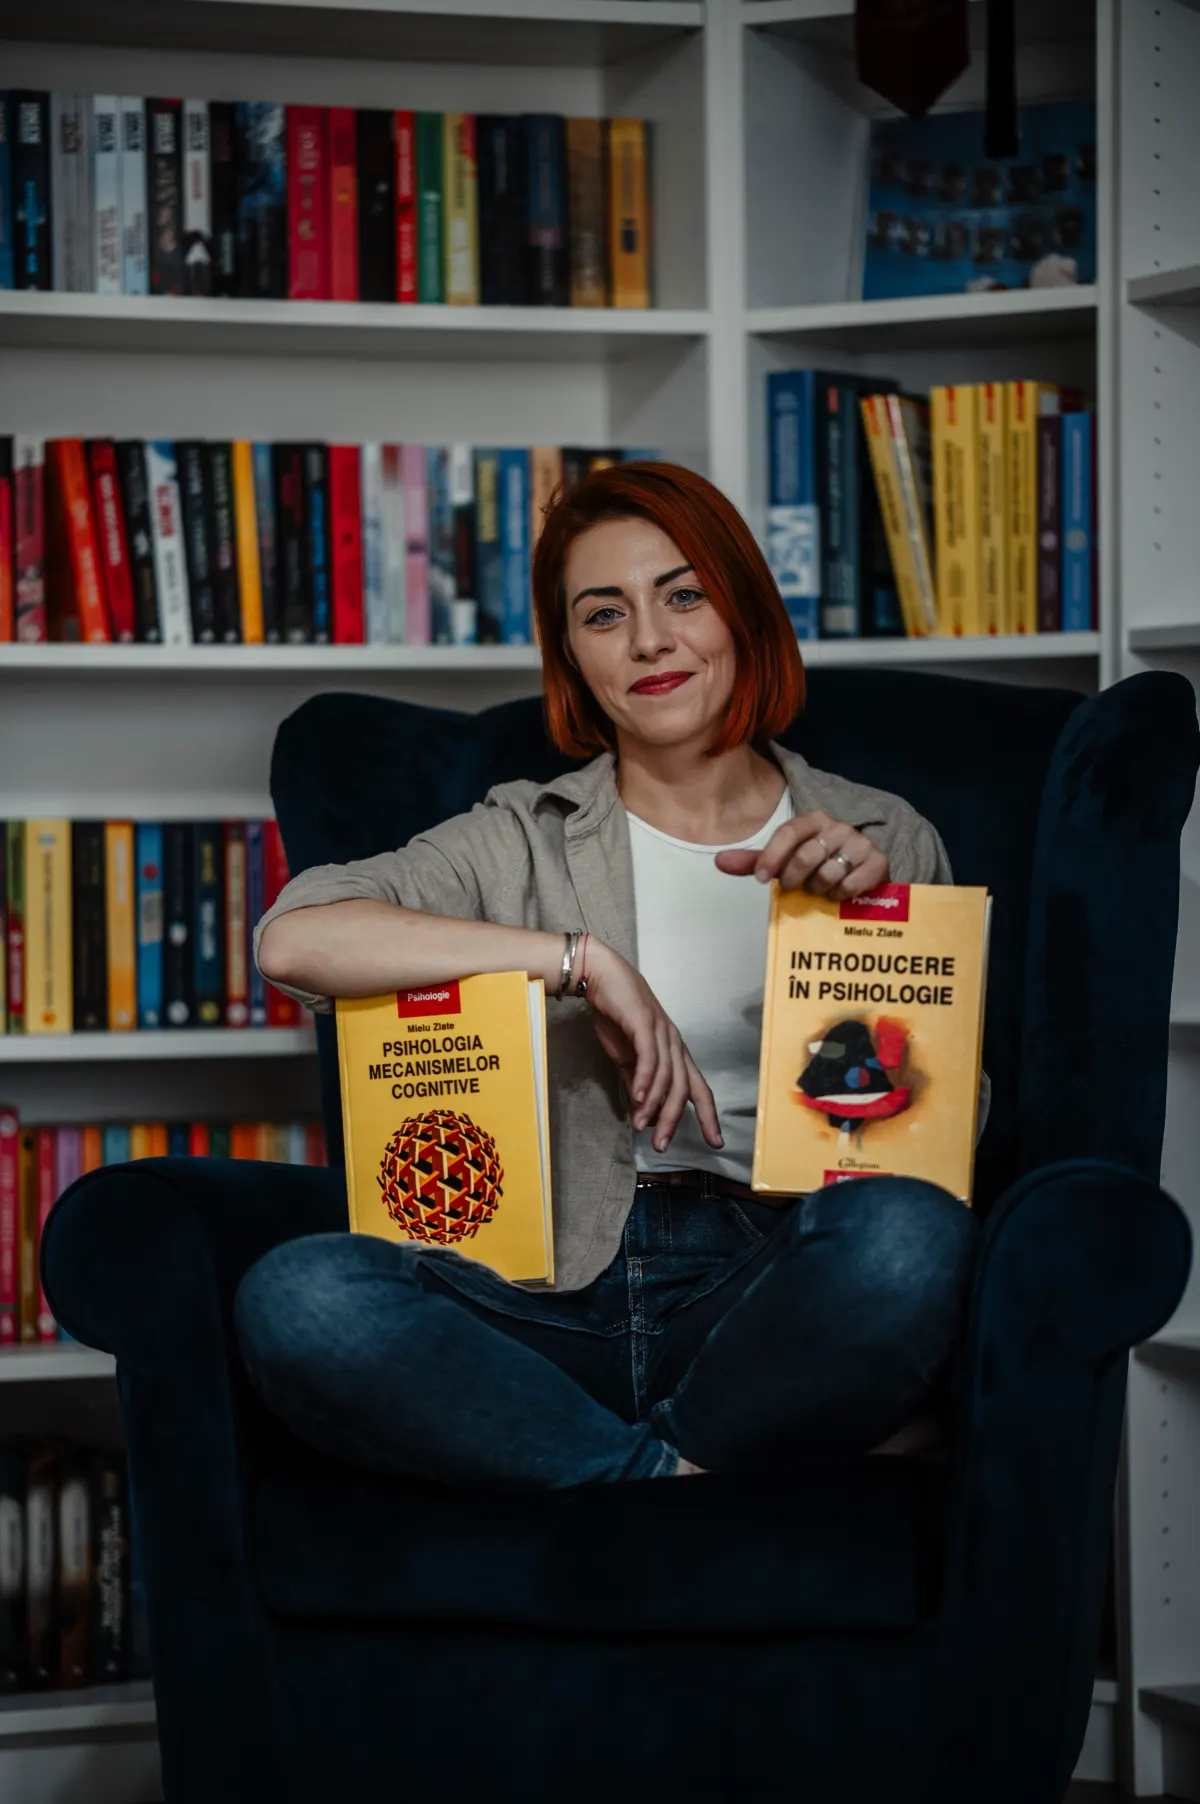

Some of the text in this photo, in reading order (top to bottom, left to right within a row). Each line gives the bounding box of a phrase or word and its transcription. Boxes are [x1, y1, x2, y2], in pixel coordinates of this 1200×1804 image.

[851, 896, 900, 909] Psihologie
[844, 926, 904, 938] Mielu Zlate
[790, 951, 955, 975] INTRODUCERE
[407, 990, 450, 1002] Psihologie
[788, 975, 954, 1005] ÎN PSIHOLOGIE
[407, 1022, 455, 1033] Mielu Zlate
[382, 1035, 483, 1057] PSIHOLOGIA
[369, 1055, 500, 1080] MECANISMELOR
[391, 1078, 480, 1099] COGNITIVE
